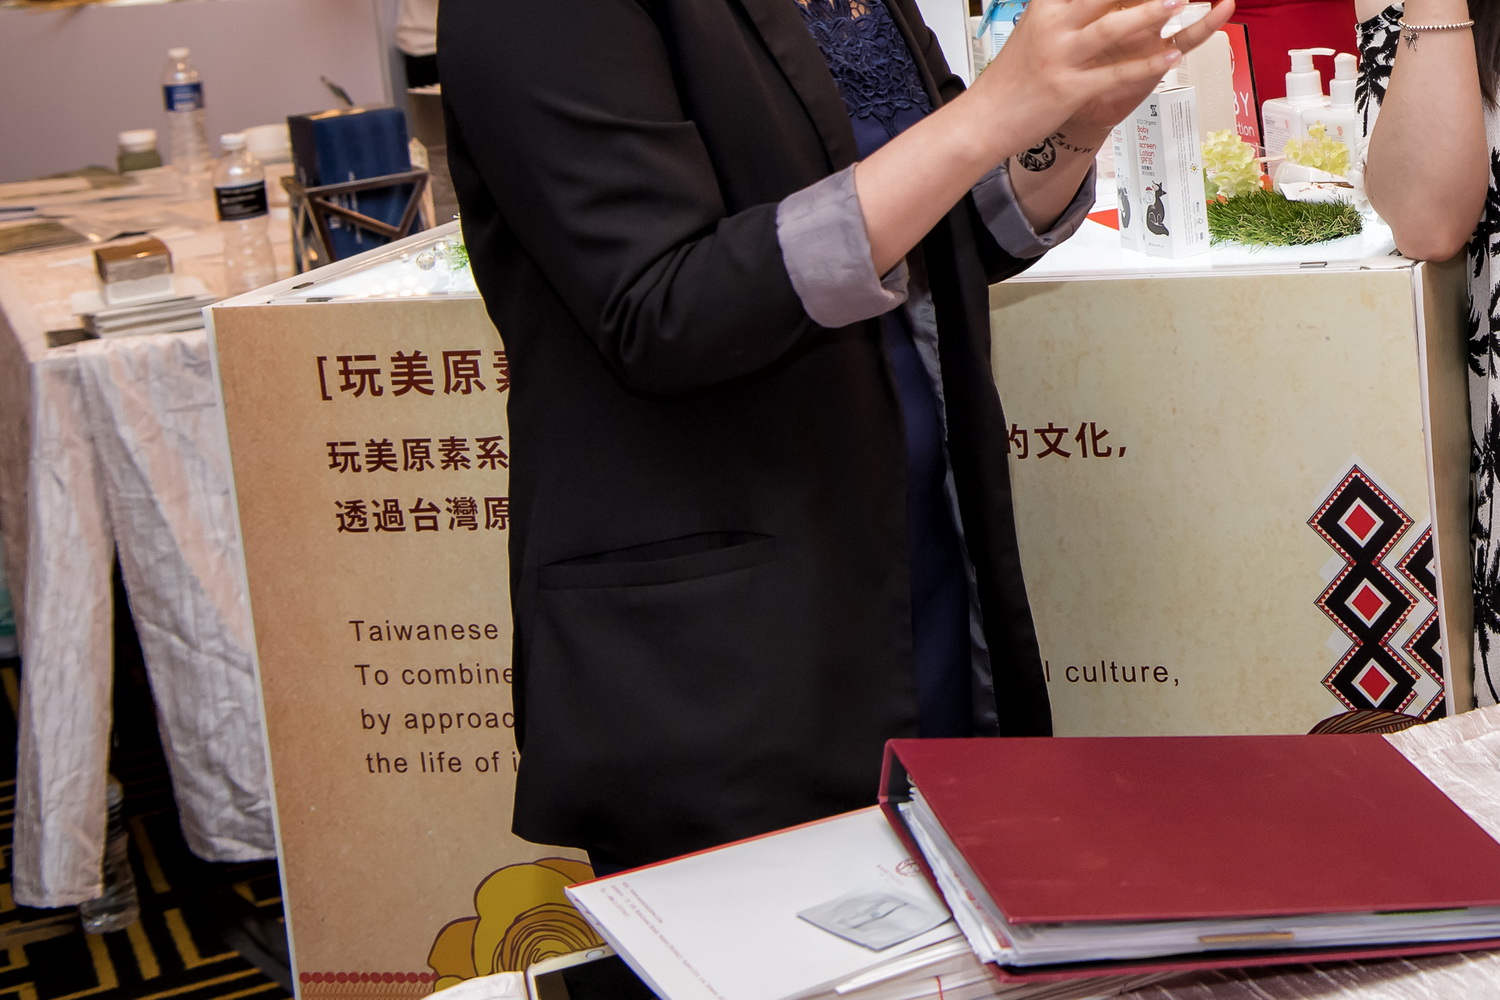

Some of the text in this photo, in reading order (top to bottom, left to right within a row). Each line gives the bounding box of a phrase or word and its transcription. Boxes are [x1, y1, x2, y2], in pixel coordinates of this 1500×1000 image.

[1233, 91, 1249, 117] BY
[1236, 121, 1255, 137] tion
[349, 619, 499, 642] Taiwanese
[355, 663, 513, 686] To combine
[1065, 660, 1180, 687] culture,
[361, 708, 515, 734] by approac
[366, 752, 409, 774] the
[421, 751, 462, 773] life
[475, 751, 500, 773] of
